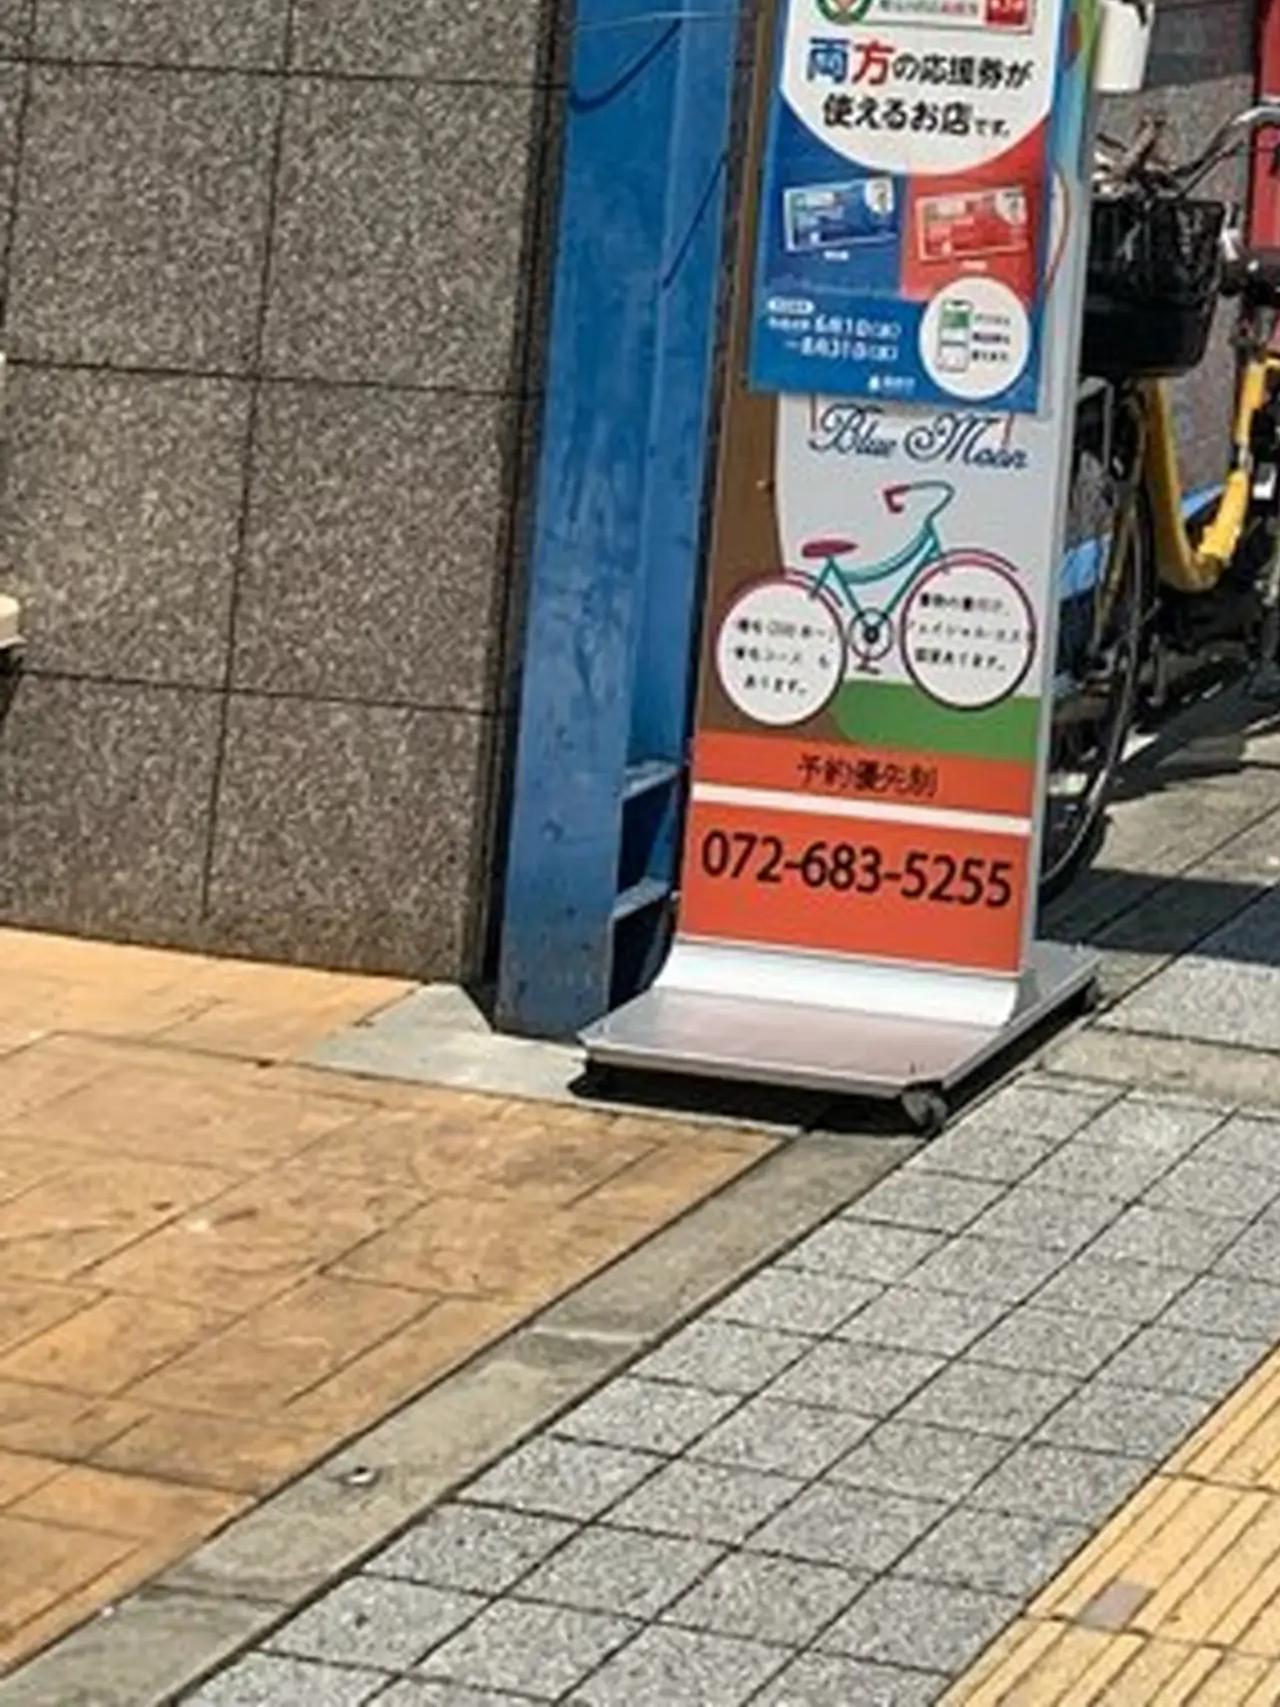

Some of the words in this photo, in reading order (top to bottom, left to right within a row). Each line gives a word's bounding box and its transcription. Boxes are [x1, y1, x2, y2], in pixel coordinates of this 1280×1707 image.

[806, 37, 1035, 89] 両方の応援券が
[808, 403, 897, 457] Blue
[904, 412, 1028, 469] Moon
[701, 829, 1013, 908] 072-683-5255
